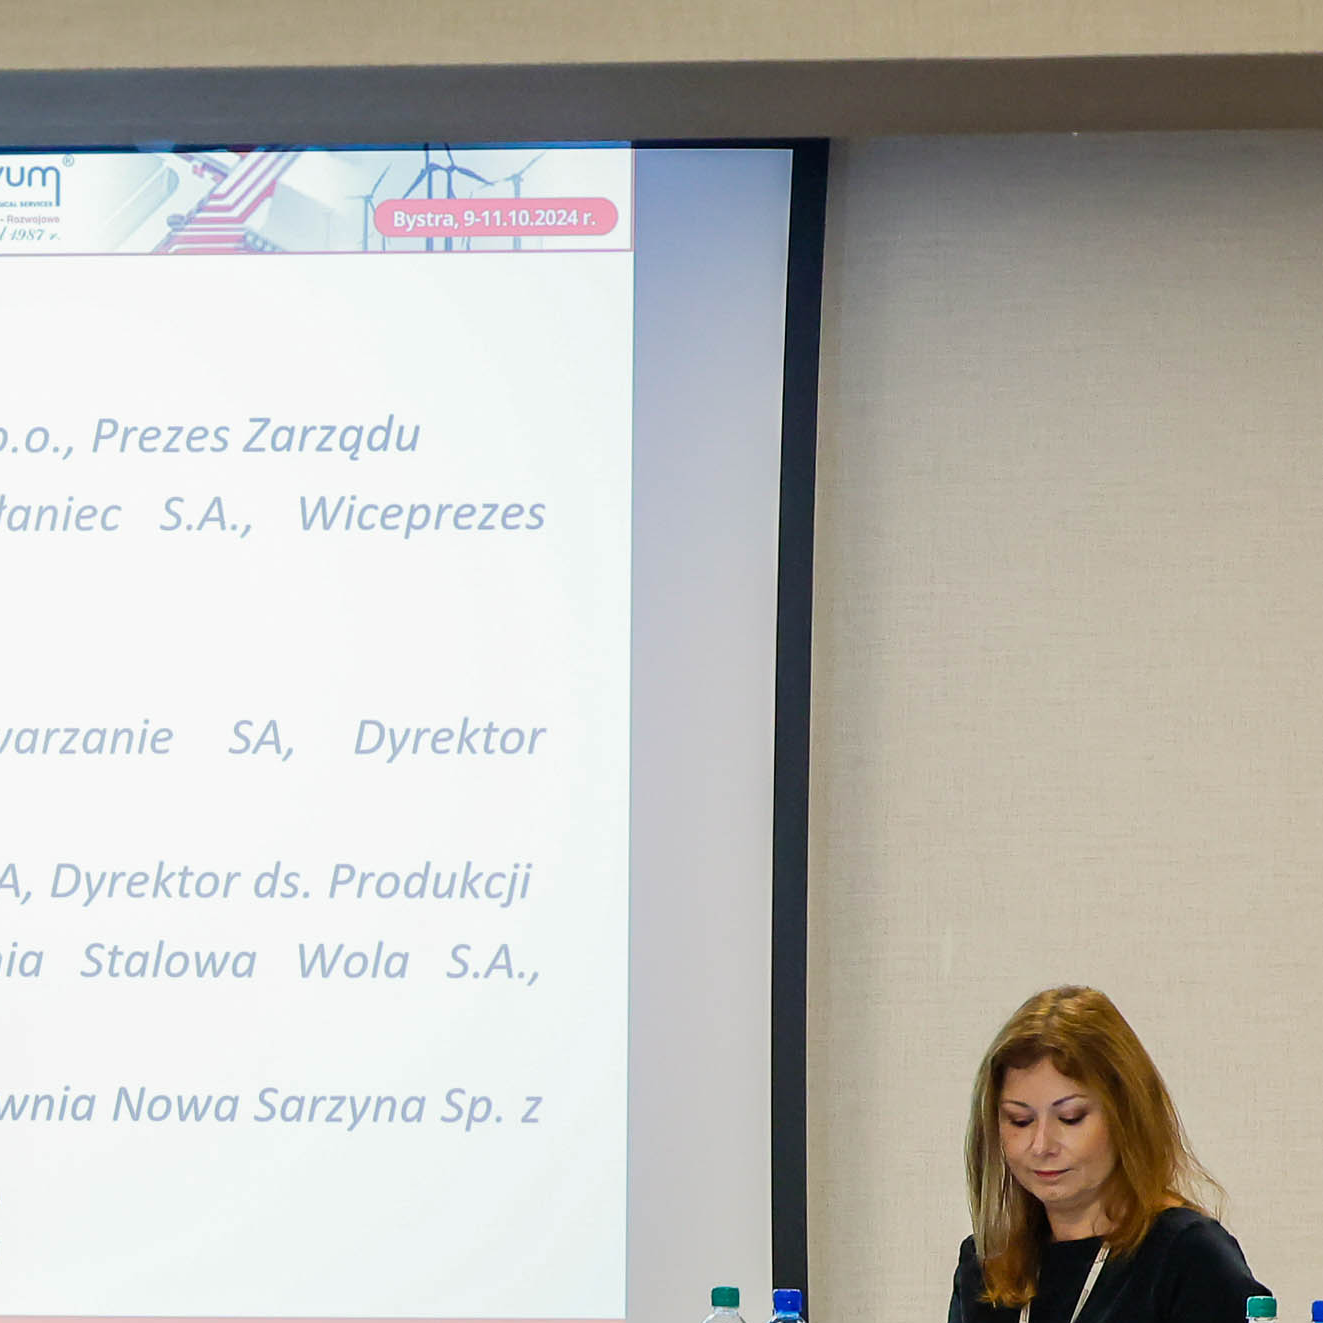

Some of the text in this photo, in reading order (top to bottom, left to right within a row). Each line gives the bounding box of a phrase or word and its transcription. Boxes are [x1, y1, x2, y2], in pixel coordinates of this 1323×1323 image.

[394, 210, 578, 232] Bystra, 9-11.10.2024
[92, 418, 230, 453] Prezes
[242, 414, 420, 461] Zarządu
[160, 496, 251, 538] S.A.,
[300, 495, 546, 539] Wiceprezes
[228, 720, 293, 762] SA,
[354, 717, 547, 763] Dyrektor
[51, 861, 241, 907] Dyrektor
[254, 861, 309, 898] ds.
[329, 861, 532, 908] Produkcji
[80, 940, 256, 978] Stalowa
[299, 940, 409, 978] Wola
[446, 944, 538, 986] S.A.,
[113, 1086, 239, 1122] Nowa
[254, 1087, 426, 1131] Sarzyna
[440, 1088, 502, 1132] Sp.
